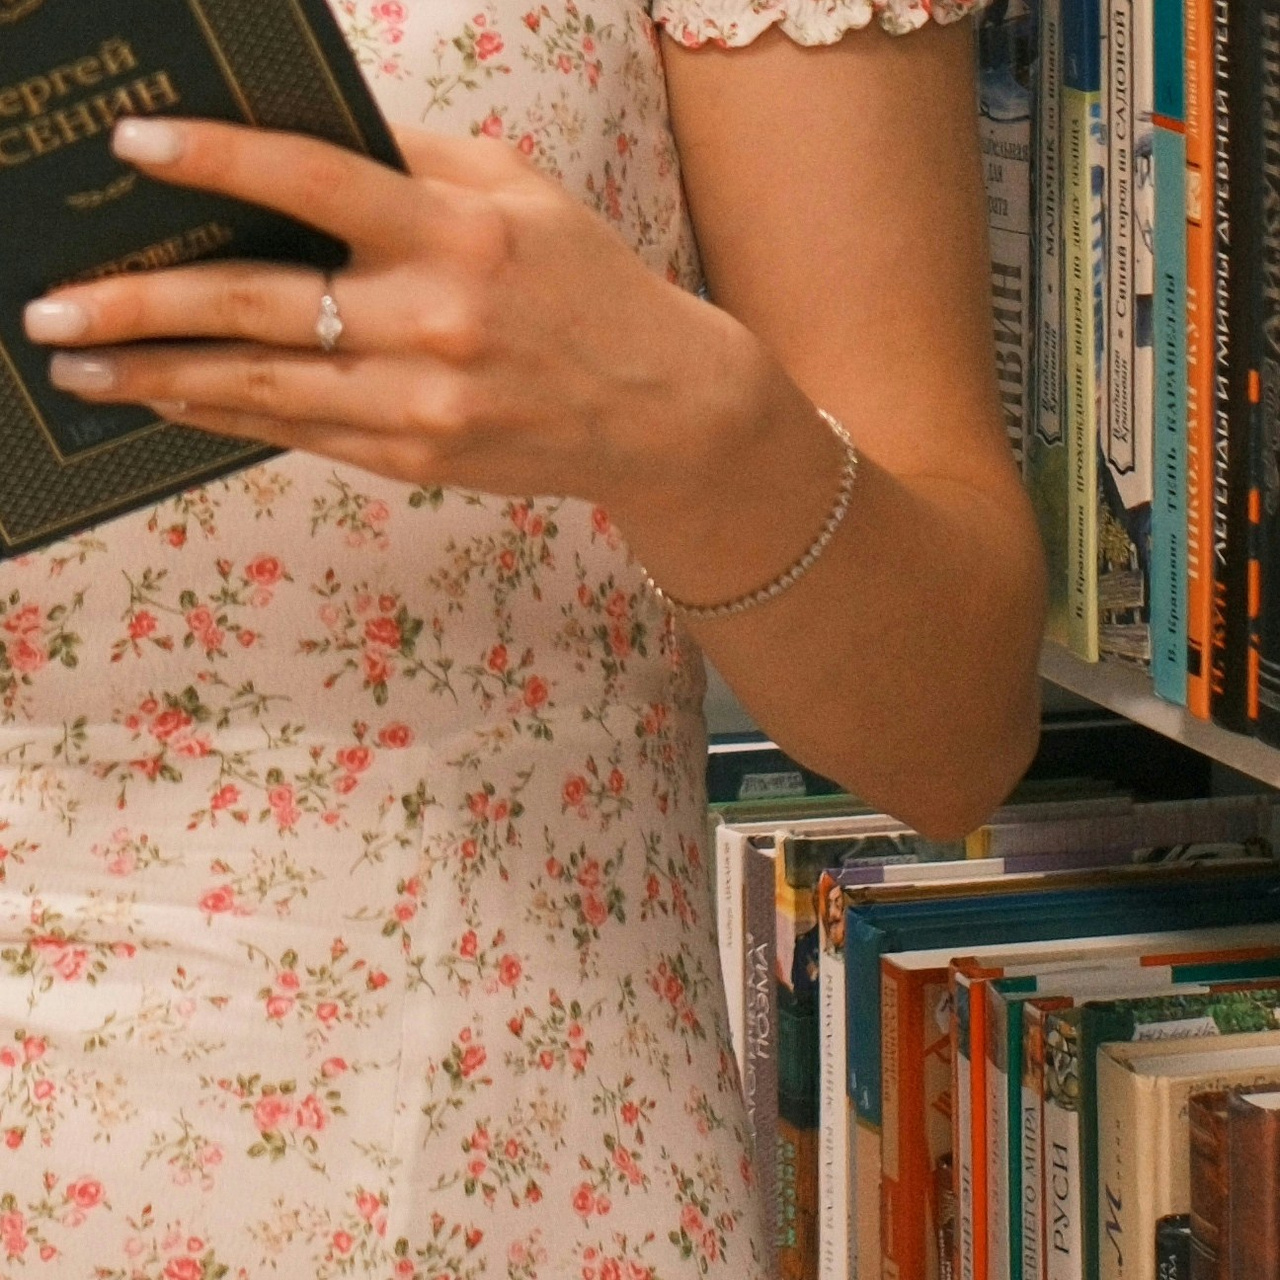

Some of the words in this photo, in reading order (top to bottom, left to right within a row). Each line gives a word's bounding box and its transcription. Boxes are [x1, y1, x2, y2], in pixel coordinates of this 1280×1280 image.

[1113, 9, 1130, 140] САДОВОЙ
[1045, 139, 1057, 257] МАЛЬЧИК
[1115, 178, 1129, 239] город
[1116, 147, 1126, 172] на
[1215, 88, 1230, 245] ДРЕВНЕЙ
[1115, 245, 1128, 319] Синий
[1216, 251, 1230, 367] МИФЫ
[1164, 272, 1178, 434] КАРАВЕЛЛЫ
[1215, 374, 1229, 401] И
[1075, 364, 1085, 494] ПРОХОЖДЕНИЕ
[1166, 447, 1178, 515] ТЕНЬ
[1214, 409, 1229, 566] ЛЕГЕНДЫ
[1076, 504, 1086, 594] Крапивин
[1166, 532, 1179, 635] Крапивин
[755, 942, 769, 1060] ПОЭМА
[1023, 1105, 1037, 1179] МИРА
[1052, 1141, 1071, 1255] РУСИ
